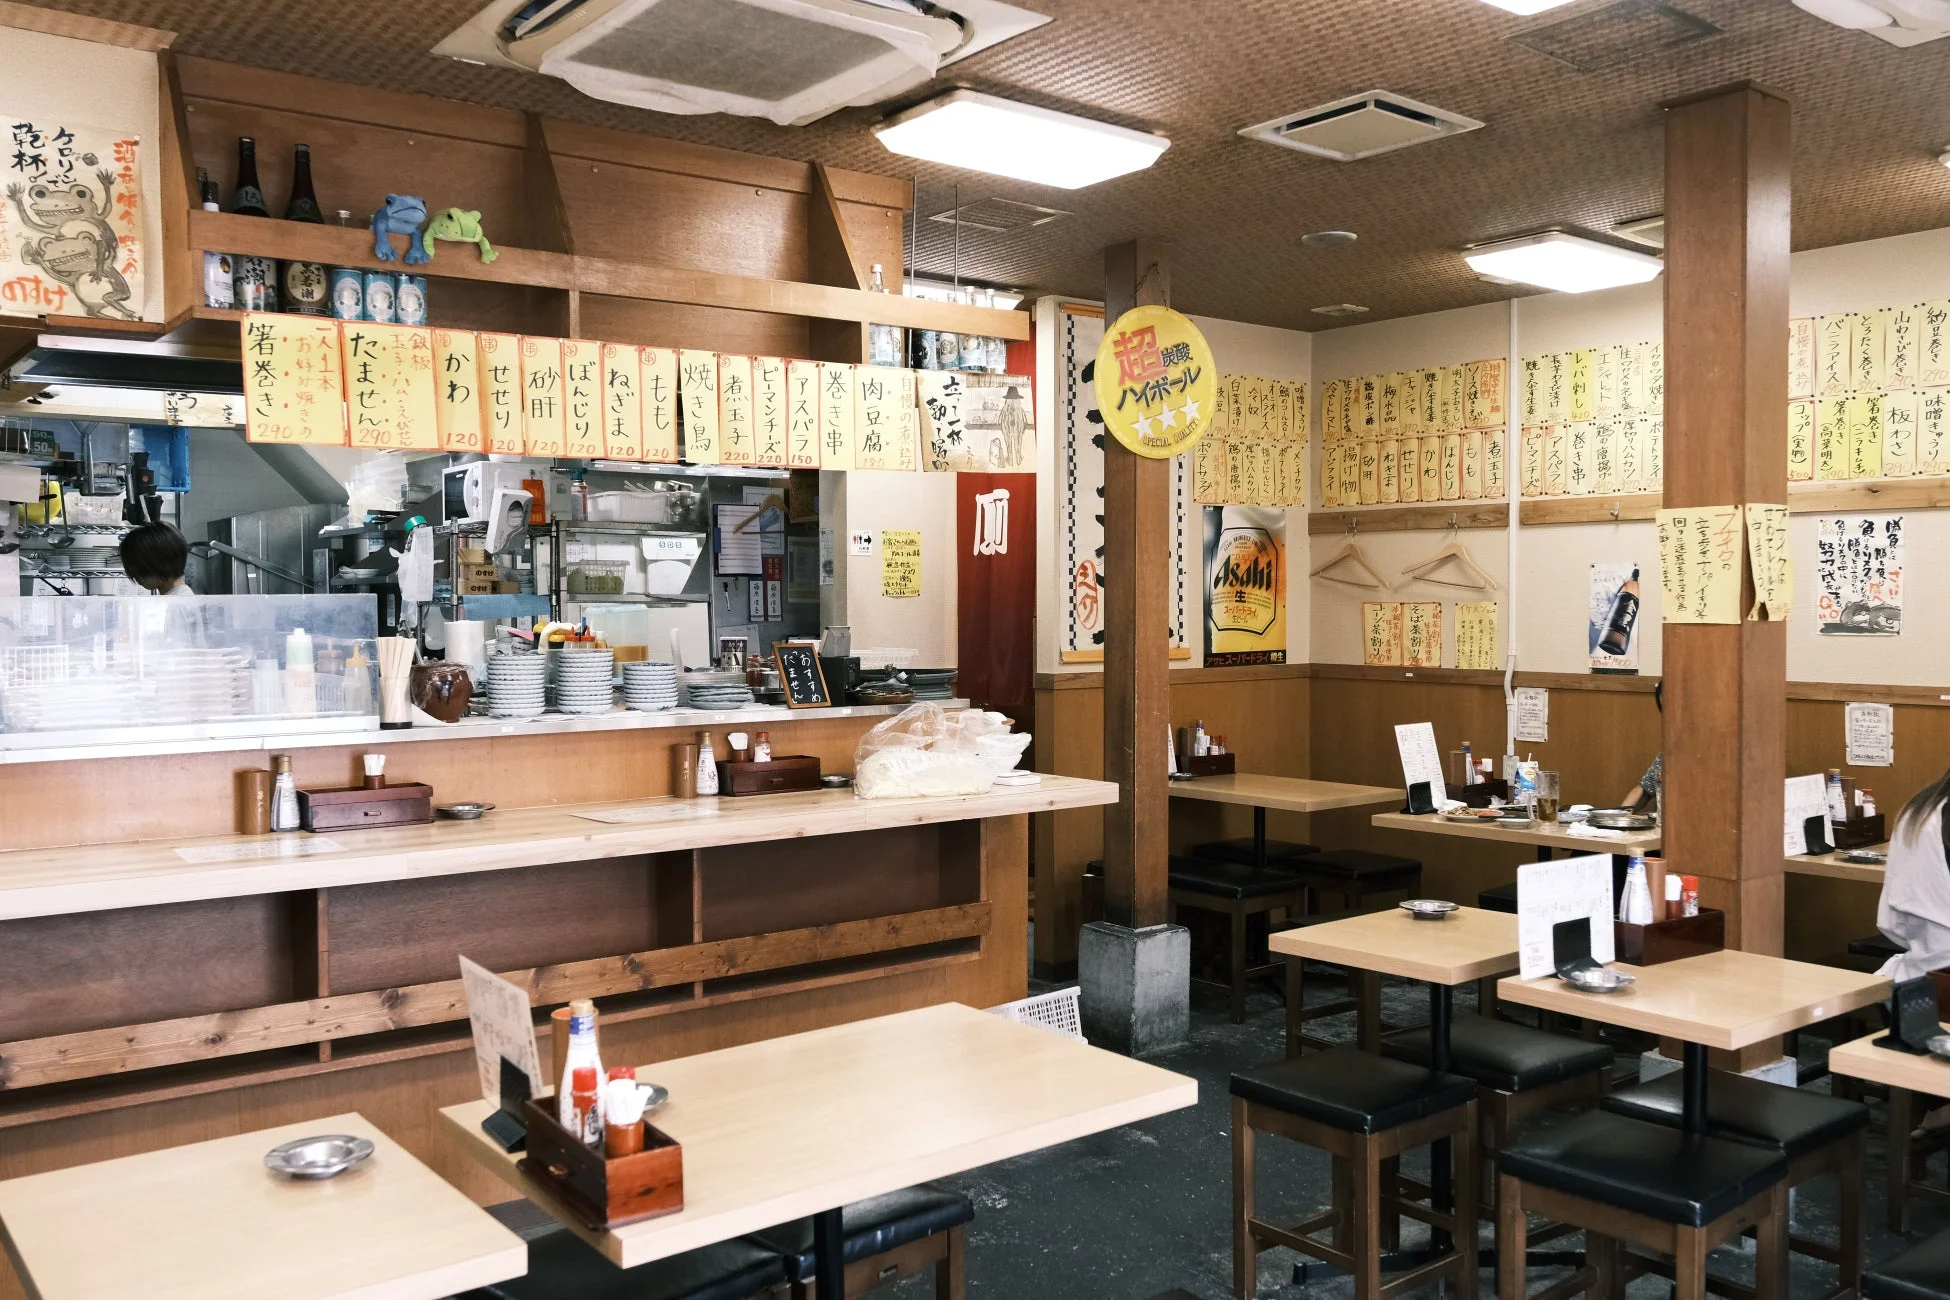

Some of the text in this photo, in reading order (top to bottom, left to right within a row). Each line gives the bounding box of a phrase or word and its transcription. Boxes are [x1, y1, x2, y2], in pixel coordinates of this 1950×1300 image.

[47, 126, 77, 188] ケロリンで
[1112, 325, 1168, 386] 超
[1161, 341, 1193, 368] 炭酸
[1825, 319, 1845, 383] バニラアイス
[1927, 307, 1947, 363] 納豆巻き
[248, 322, 277, 418] 箸巻き
[350, 332, 381, 427] たません
[445, 353, 470, 404] かわ
[528, 366, 560, 419] 砂肝
[1116, 366, 1202, 411] ハイボール
[1573, 353, 1587, 409] レバ刺し
[488, 365, 511, 429] せせり
[569, 361, 597, 439] ぼんじり
[608, 368, 635, 438] ねぎま
[650, 374, 670, 430] もも
[684, 363, 714, 452] 焼き鳥
[723, 374, 749, 446] 煮玉子
[763, 367, 781, 454] ピーマンチーズ
[792, 377, 814, 452] アスパラ
[826, 370, 847, 456] 巻き串
[861, 377, 883, 453] 肉豆腐
[942, 375, 964, 447] 立って一杯
[1248, 387, 1259, 416] 冷奴
[1866, 397, 1880, 444] 箸巻き
[257, 423, 294, 440] 290
[359, 428, 391, 445] 290
[446, 432, 478, 446] 120
[490, 438, 515, 452] 120
[530, 438, 559, 454] 120
[1142, 420, 1198, 447] SPECIAL QUALITY
[1833, 400, 1847, 445] 箸巻き
[1887, 407, 1914, 457] 板わさ
[1925, 395, 1946, 461] 味噌きゅうり
[34, 441, 49, 453] 50
[569, 442, 597, 455] 120
[609, 445, 635, 457] 120
[645, 448, 670, 459] 120
[724, 452, 750, 461] 220
[758, 454, 782, 464] 220
[791, 455, 813, 465] 150
[1229, 443, 1240, 492] 鶏の唐揚げ
[1342, 447, 1357, 493] 揚げ物
[1402, 450, 1415, 490] せせり
[1424, 449, 1437, 478] かわ
[1466, 444, 1477, 477] もも
[1488, 440, 1501, 484] 煮玉子
[1548, 436, 1563, 483] アスパラ
[1572, 432, 1586, 485] 巻き串
[1596, 423, 1615, 480] 鶏の唐揚げ
[475, 569, 495, 577] のすけ
[1213, 554, 1273, 593] Asahi
[1223, 606, 1257, 617] スーパードライ
[1234, 590, 1247, 604] 生
[1371, 604, 1382, 655] コーン茶割り
[1410, 605, 1423, 657] そば茶割り
[800, 653, 821, 702] おすすめ
[1207, 656, 1225, 666] アサヒ
[1225, 652, 1270, 665] スーパードライ
